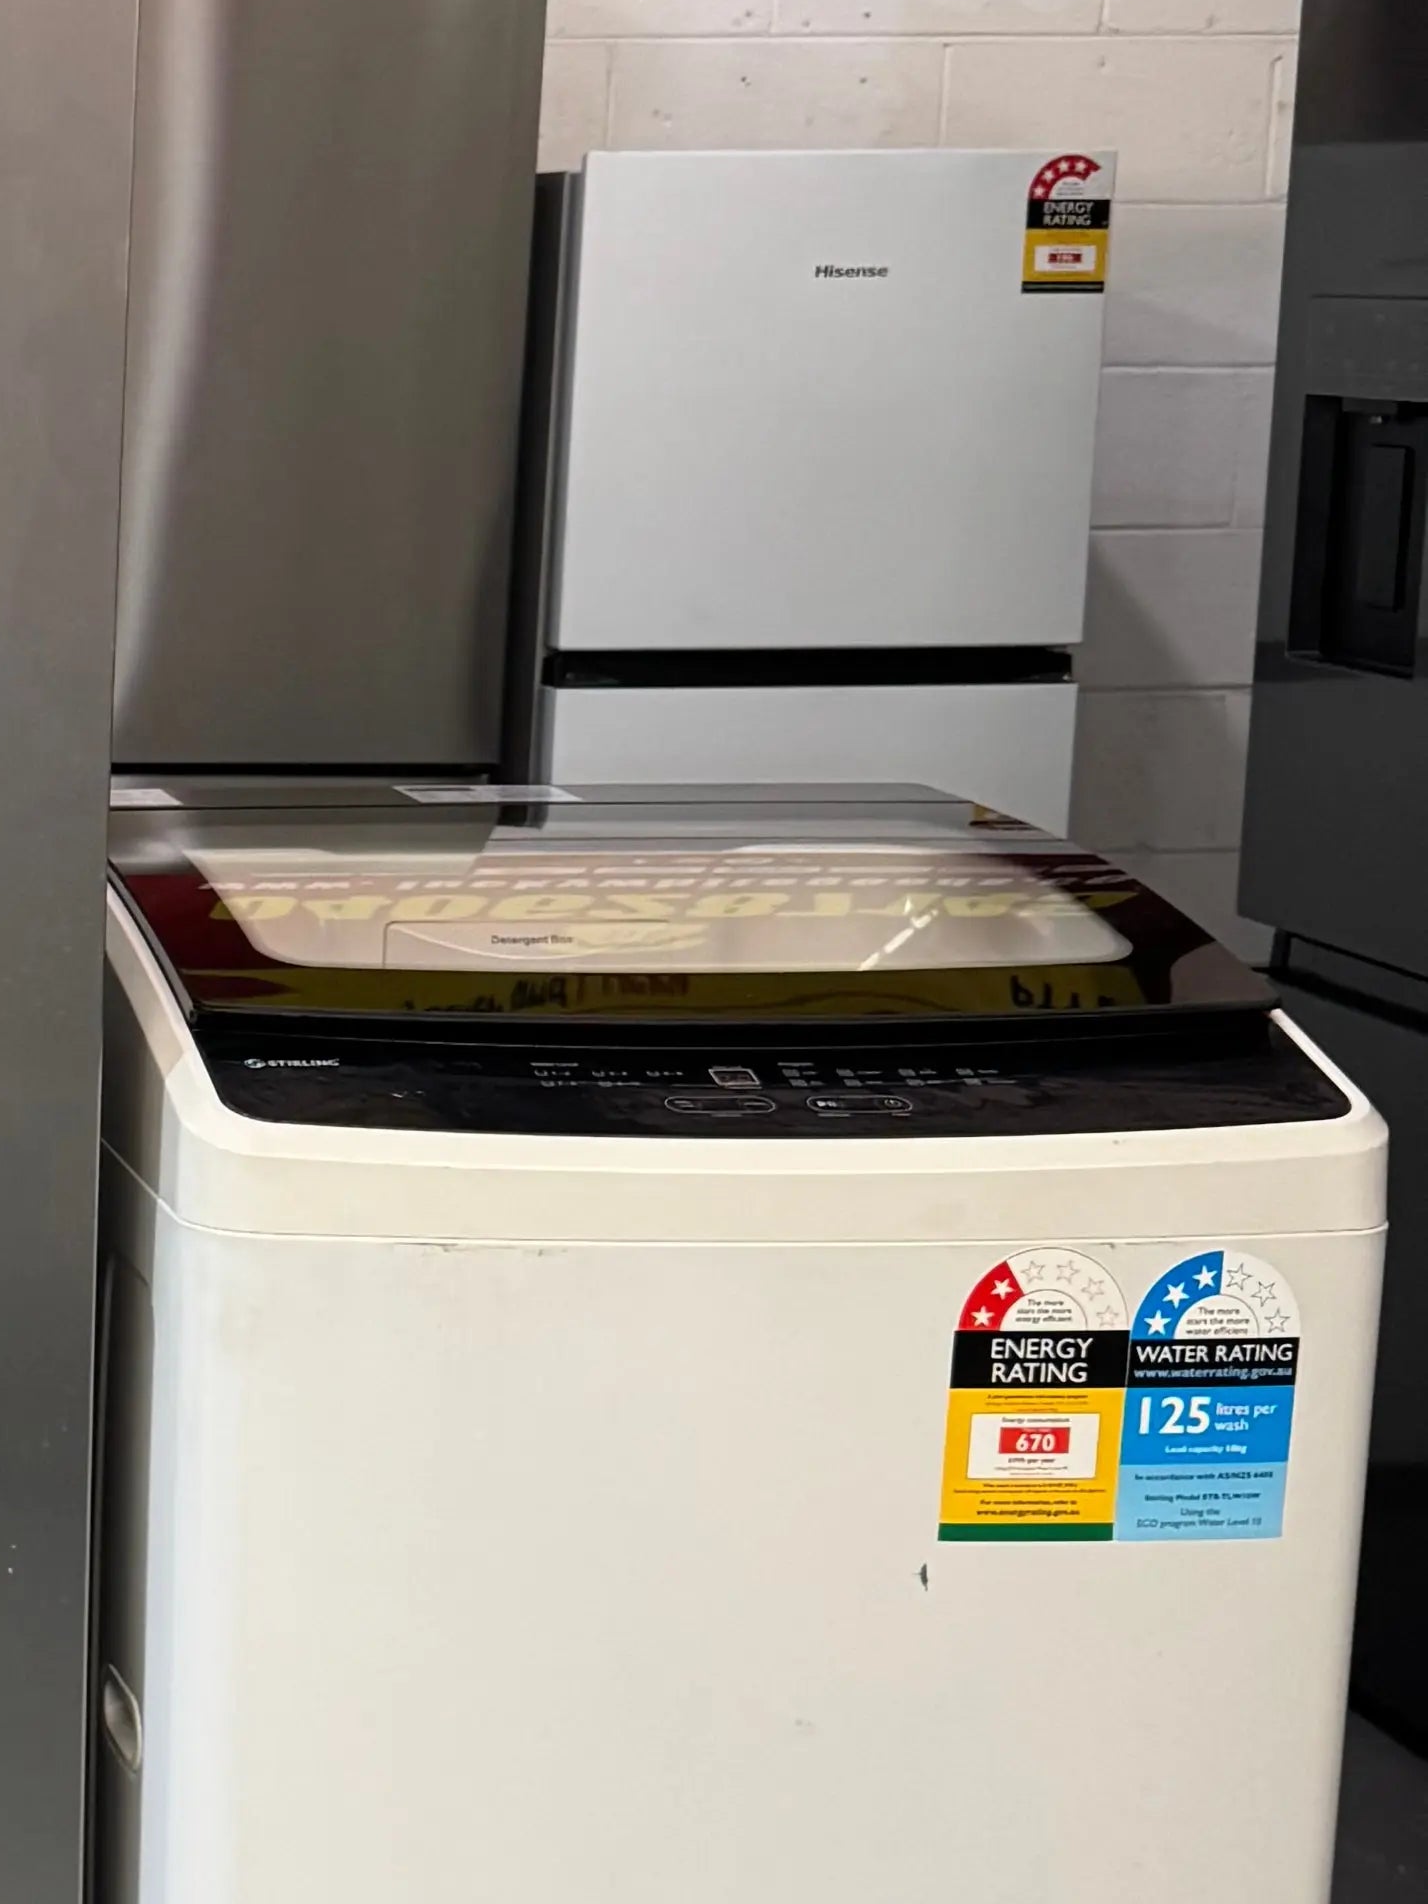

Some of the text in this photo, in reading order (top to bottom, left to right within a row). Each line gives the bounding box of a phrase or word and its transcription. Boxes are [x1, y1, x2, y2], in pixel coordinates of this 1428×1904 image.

[814, 264, 889, 278] Hisense
[491, 934, 548, 946] Detergent
[267, 1058, 340, 1067] STIRLING
[1197, 1306, 1240, 1316] The more
[991, 1337, 1095, 1360] ENERGY
[1136, 1343, 1294, 1364] WATER RATING
[991, 1362, 1088, 1384] RATING
[1133, 1365, 1293, 1381] www.waterrating.gov.au
[1139, 1395, 1278, 1435] 125 litres per
[1214, 1418, 1249, 1432] wash
[1015, 1432, 1056, 1453] 670
